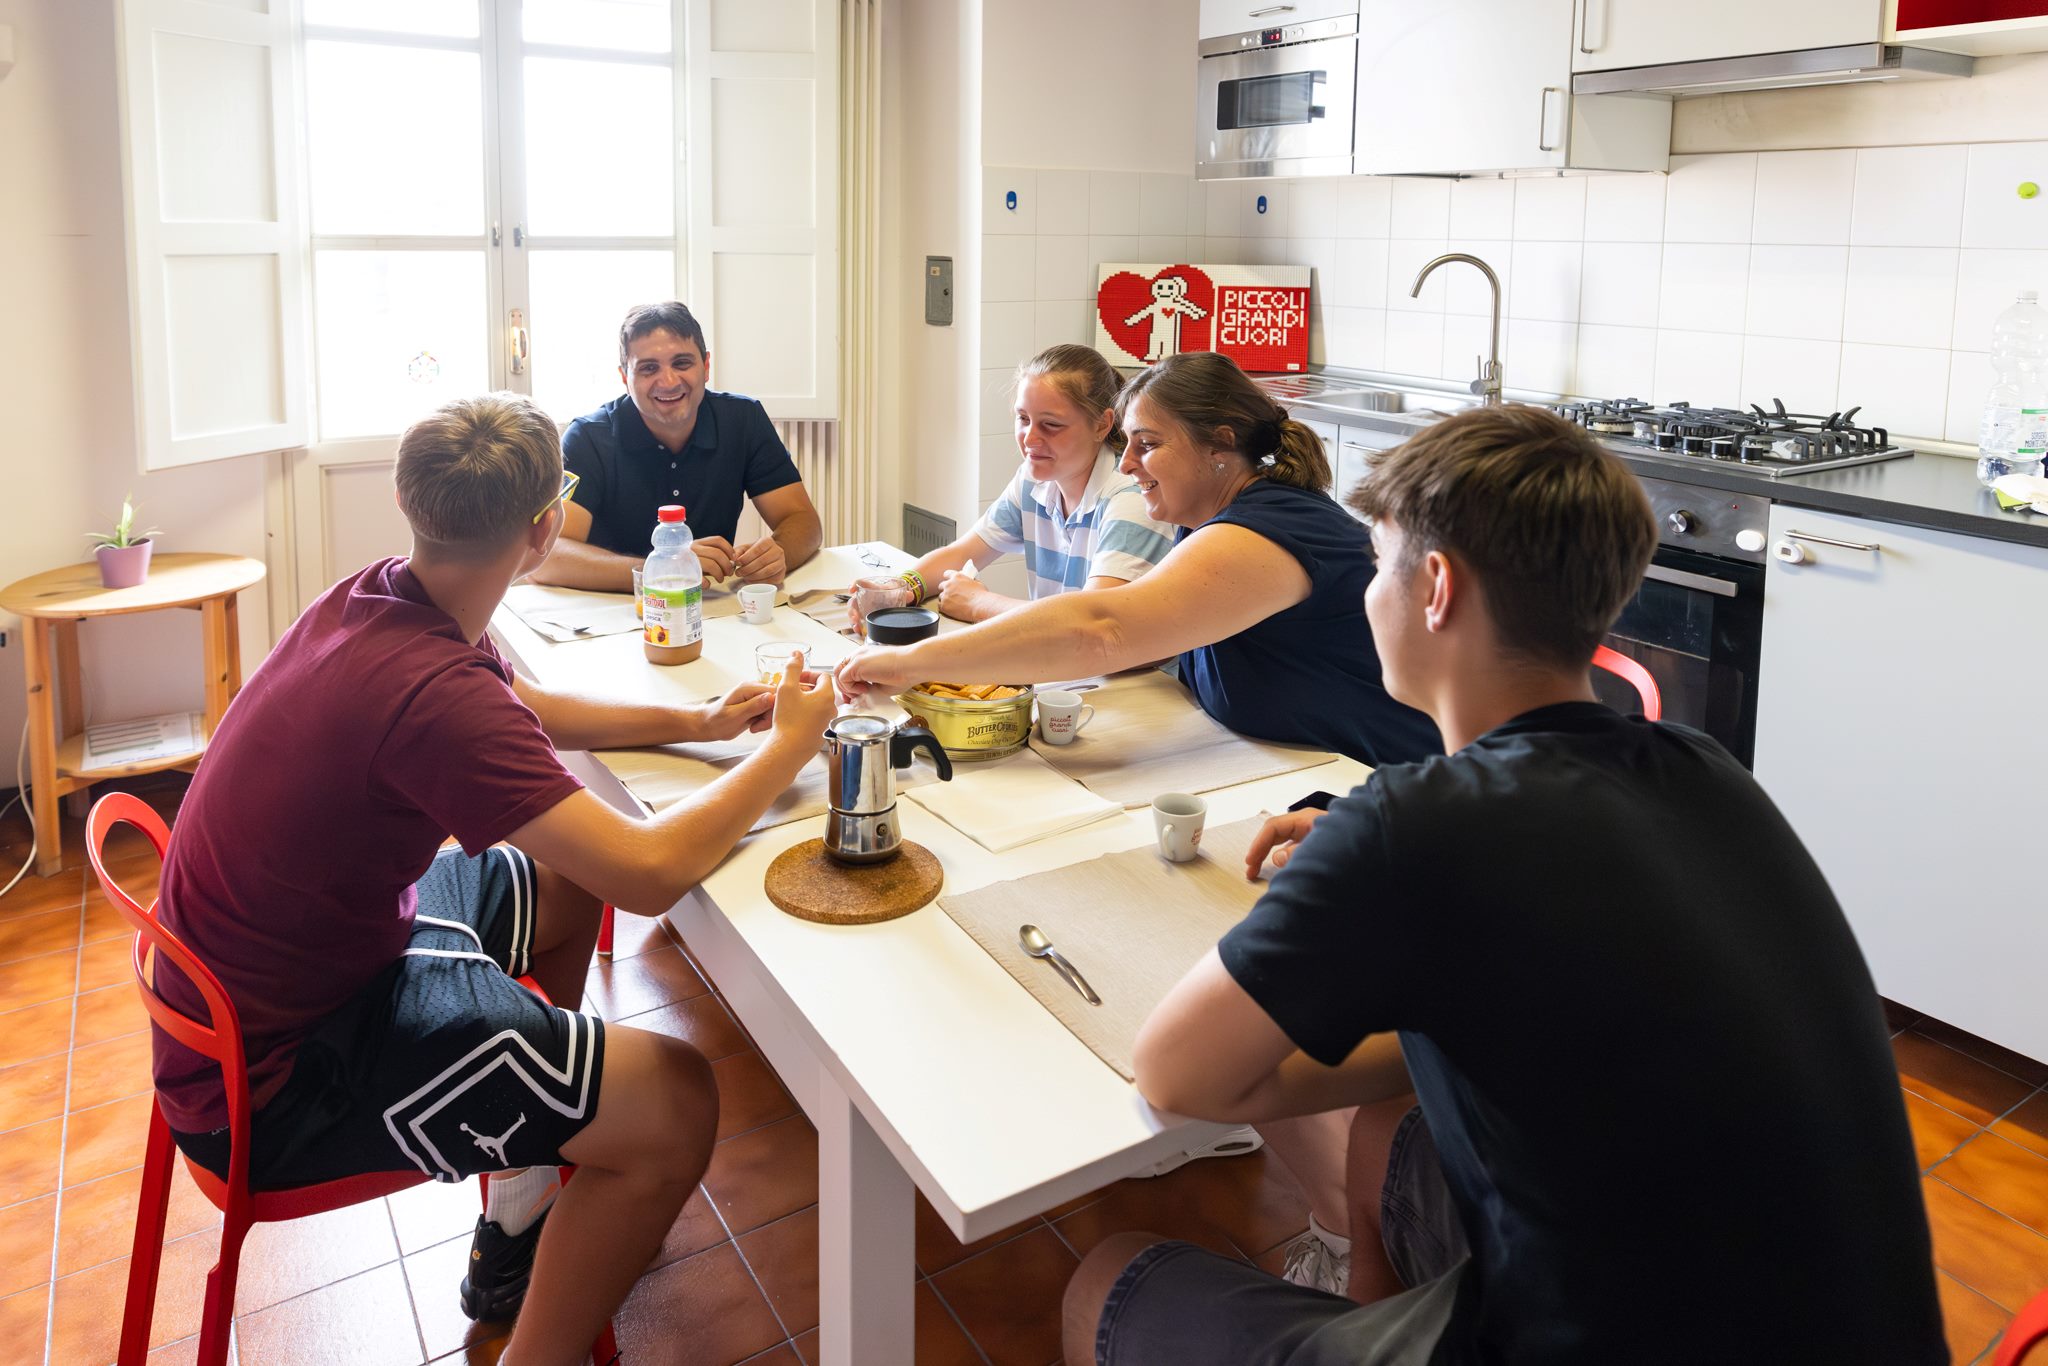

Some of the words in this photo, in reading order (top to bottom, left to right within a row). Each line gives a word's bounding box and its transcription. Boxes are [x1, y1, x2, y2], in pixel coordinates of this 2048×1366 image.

[1225, 290, 1305, 309] PICCOLI
[1221, 308, 1304, 328] GRANDI
[1220, 327, 1287, 346] CUORI
[967, 723, 997, 739] BUTTER
